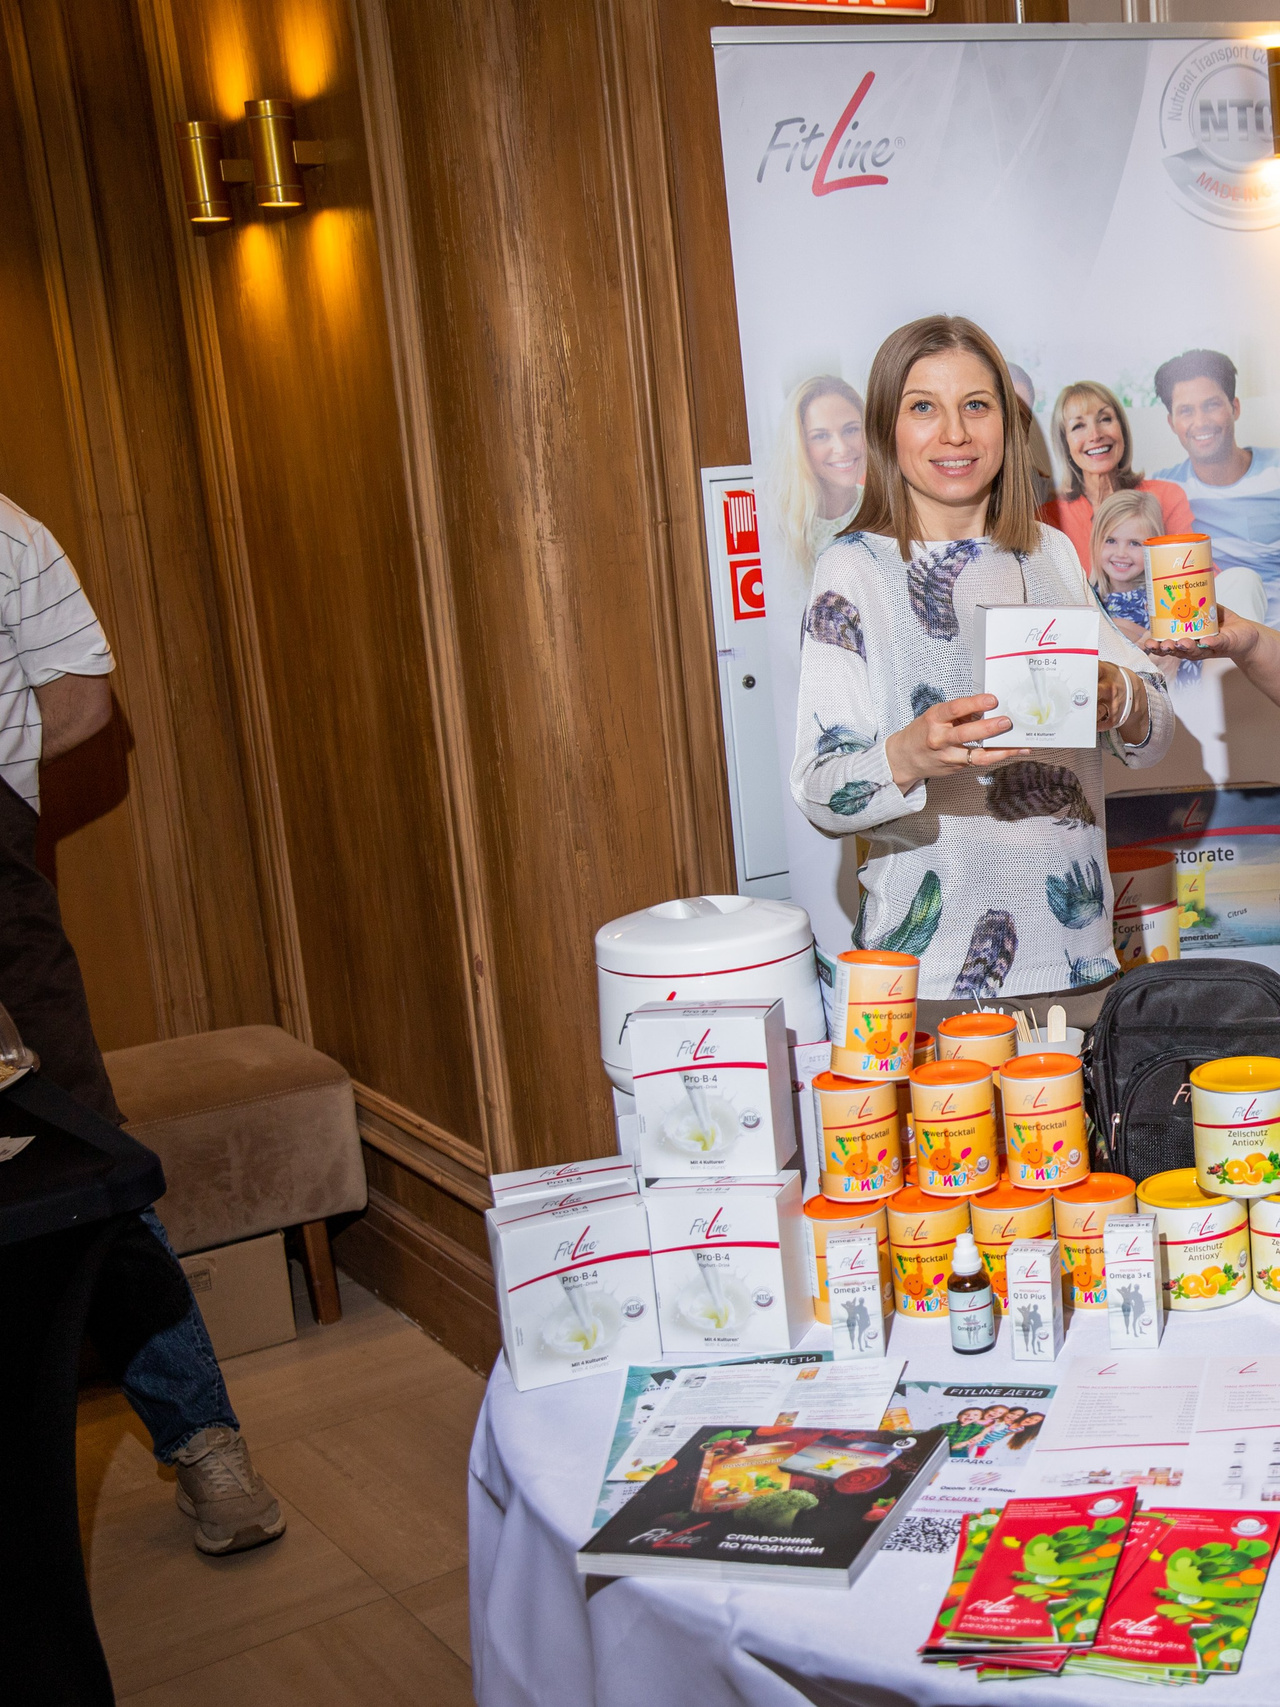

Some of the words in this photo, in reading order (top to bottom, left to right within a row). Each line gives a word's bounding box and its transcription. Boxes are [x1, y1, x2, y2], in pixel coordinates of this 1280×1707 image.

[1167, 69, 1198, 122] Nutrient
[1191, 46, 1249, 72] Transport
[1197, 172, 1239, 201] MADE
[1163, 580, 1208, 591] PowerCocktail
[1025, 618, 1061, 646] FitLine
[1173, 847, 1234, 864] storate
[1227, 908, 1247, 919] Citrus
[862, 1011, 912, 1020] PowerCocktail
[677, 1028, 720, 1061] FitLine
[1232, 1098, 1262, 1122] FitLine
[1013, 1120, 1067, 1130] PowerCocktail
[836, 1128, 890, 1143] PowerCocktail
[922, 1127, 975, 1137] PowerCocktail
[689, 1207, 731, 1239] FitLine
[1188, 1213, 1217, 1236] FitLine
[554, 1225, 600, 1261] FitLine
[1064, 1245, 1104, 1254] PowerCock
[896, 1253, 948, 1263] PowerCocktail
[626, 1303, 640, 1312] NTC
[783, 1354, 817, 1365] ДЕТИ
[1004, 1389, 1044, 1397] ДЕТИ
[628, 1521, 711, 1548] FitLine
[725, 1533, 815, 1545] СПРАВОЧНИК
[719, 1541, 738, 1550] ПО
[742, 1542, 825, 1555] ПРОДУКЦИИ
[963, 1614, 1043, 1625] Почувствуйте
[959, 1622, 1015, 1631] результат
